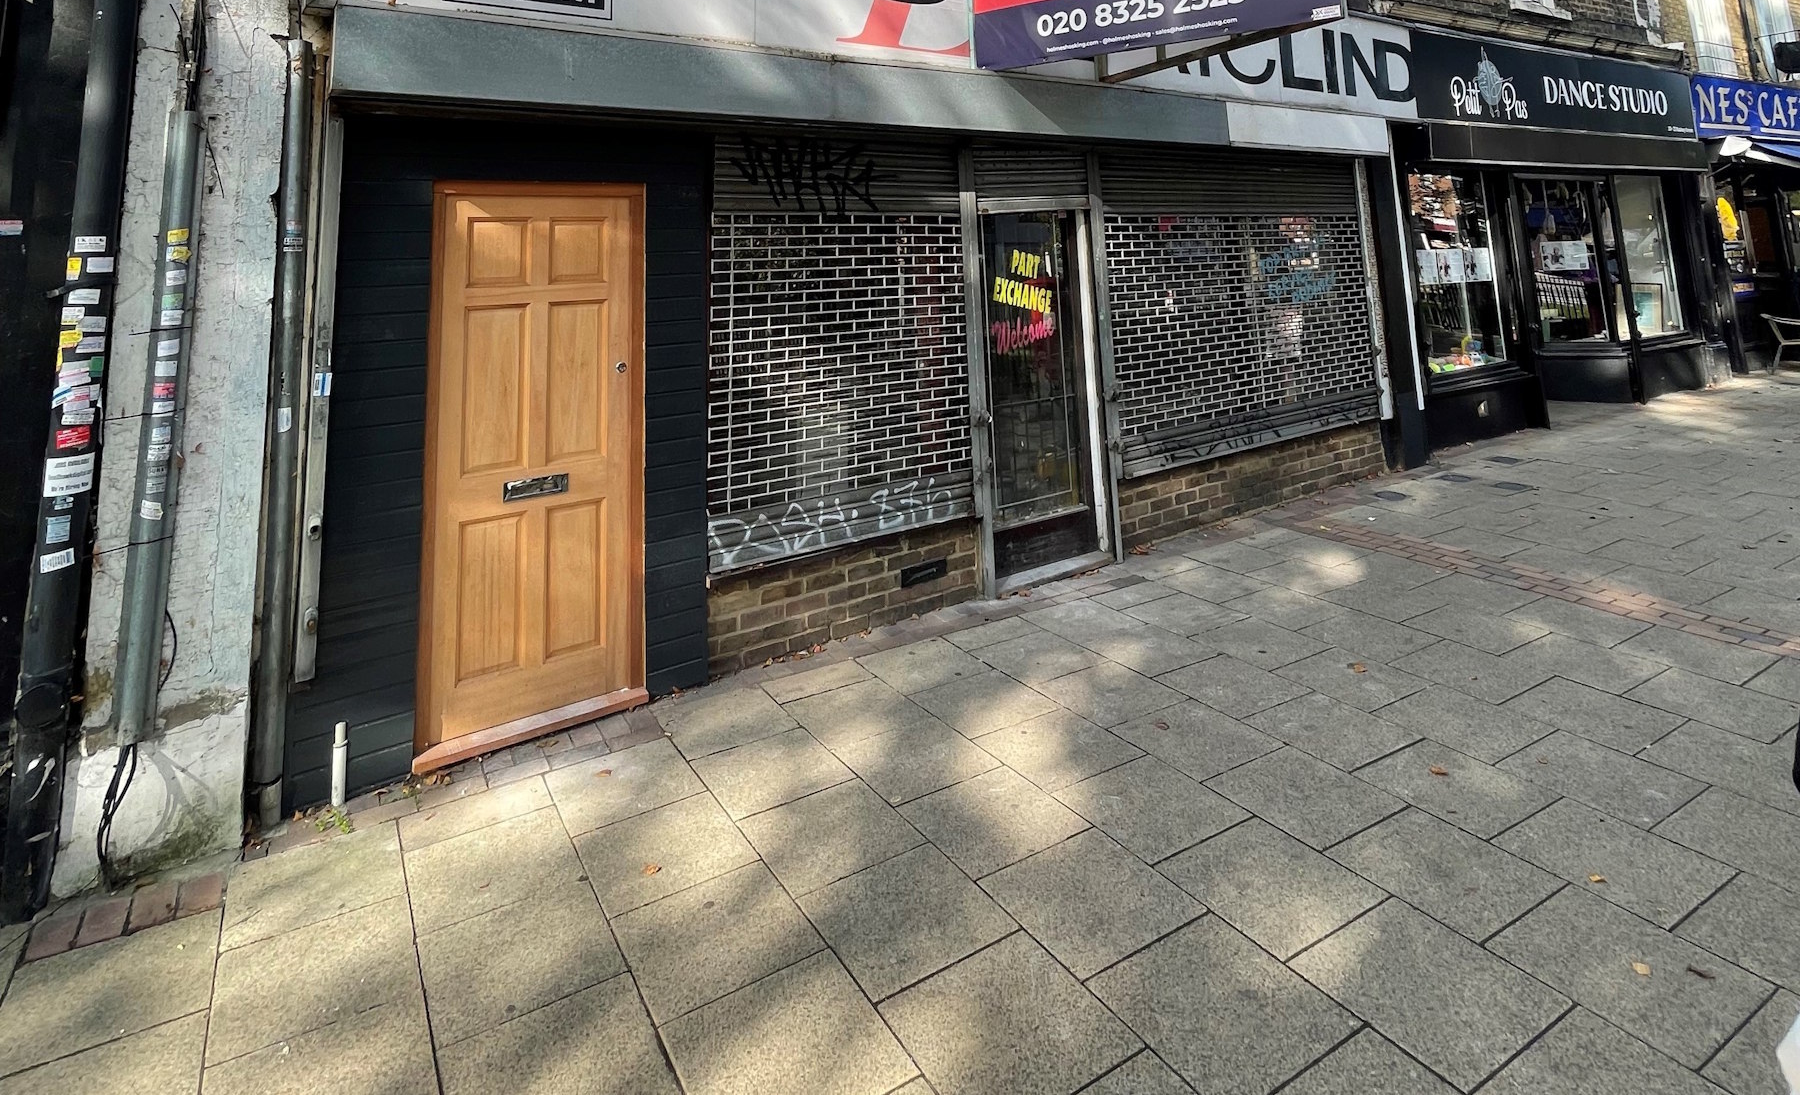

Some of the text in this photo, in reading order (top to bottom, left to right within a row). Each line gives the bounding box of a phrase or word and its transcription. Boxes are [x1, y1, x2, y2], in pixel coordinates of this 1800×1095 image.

[1036, 8, 1087, 37] 020
[1450, 75, 1529, 121] Petit Pas
[1542, 75, 1668, 118] DANCE STUDIO
[1757, 91, 1800, 128] CAF
[1011, 249, 1041, 280] PART
[992, 276, 1053, 315] EXCHANGE
[990, 316, 1055, 356] Welcome
